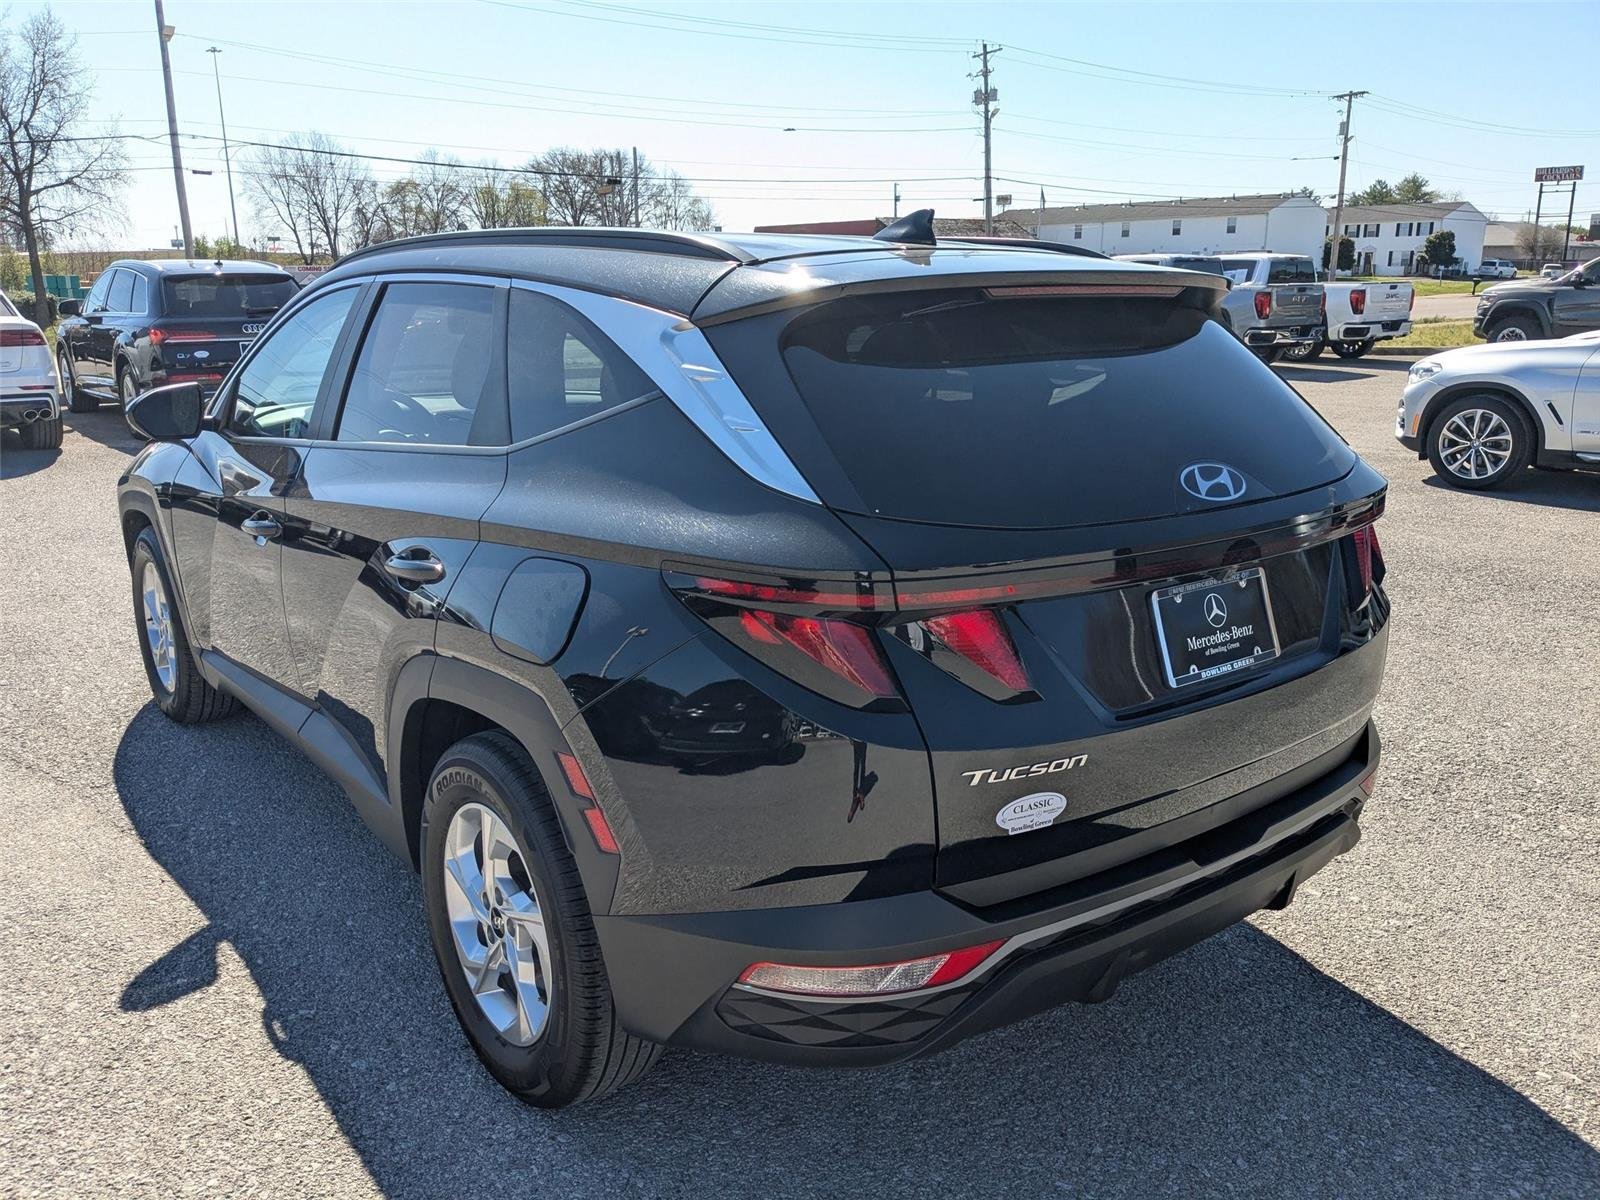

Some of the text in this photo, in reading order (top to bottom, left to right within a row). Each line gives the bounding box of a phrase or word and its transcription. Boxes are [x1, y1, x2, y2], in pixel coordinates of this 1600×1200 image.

[1187, 624, 1254, 651] Mercedes-Benz
[1211, 645, 1227, 655] Bowling
[1227, 642, 1240, 650] Green
[1201, 658, 1255, 678] BOWLING GREEN
[962, 754, 1088, 786] TUCSON
[437, 771, 483, 794] ROADIAN
[1013, 798, 1054, 814] CLASSIC
[1011, 819, 1052, 832] Bowling Green
